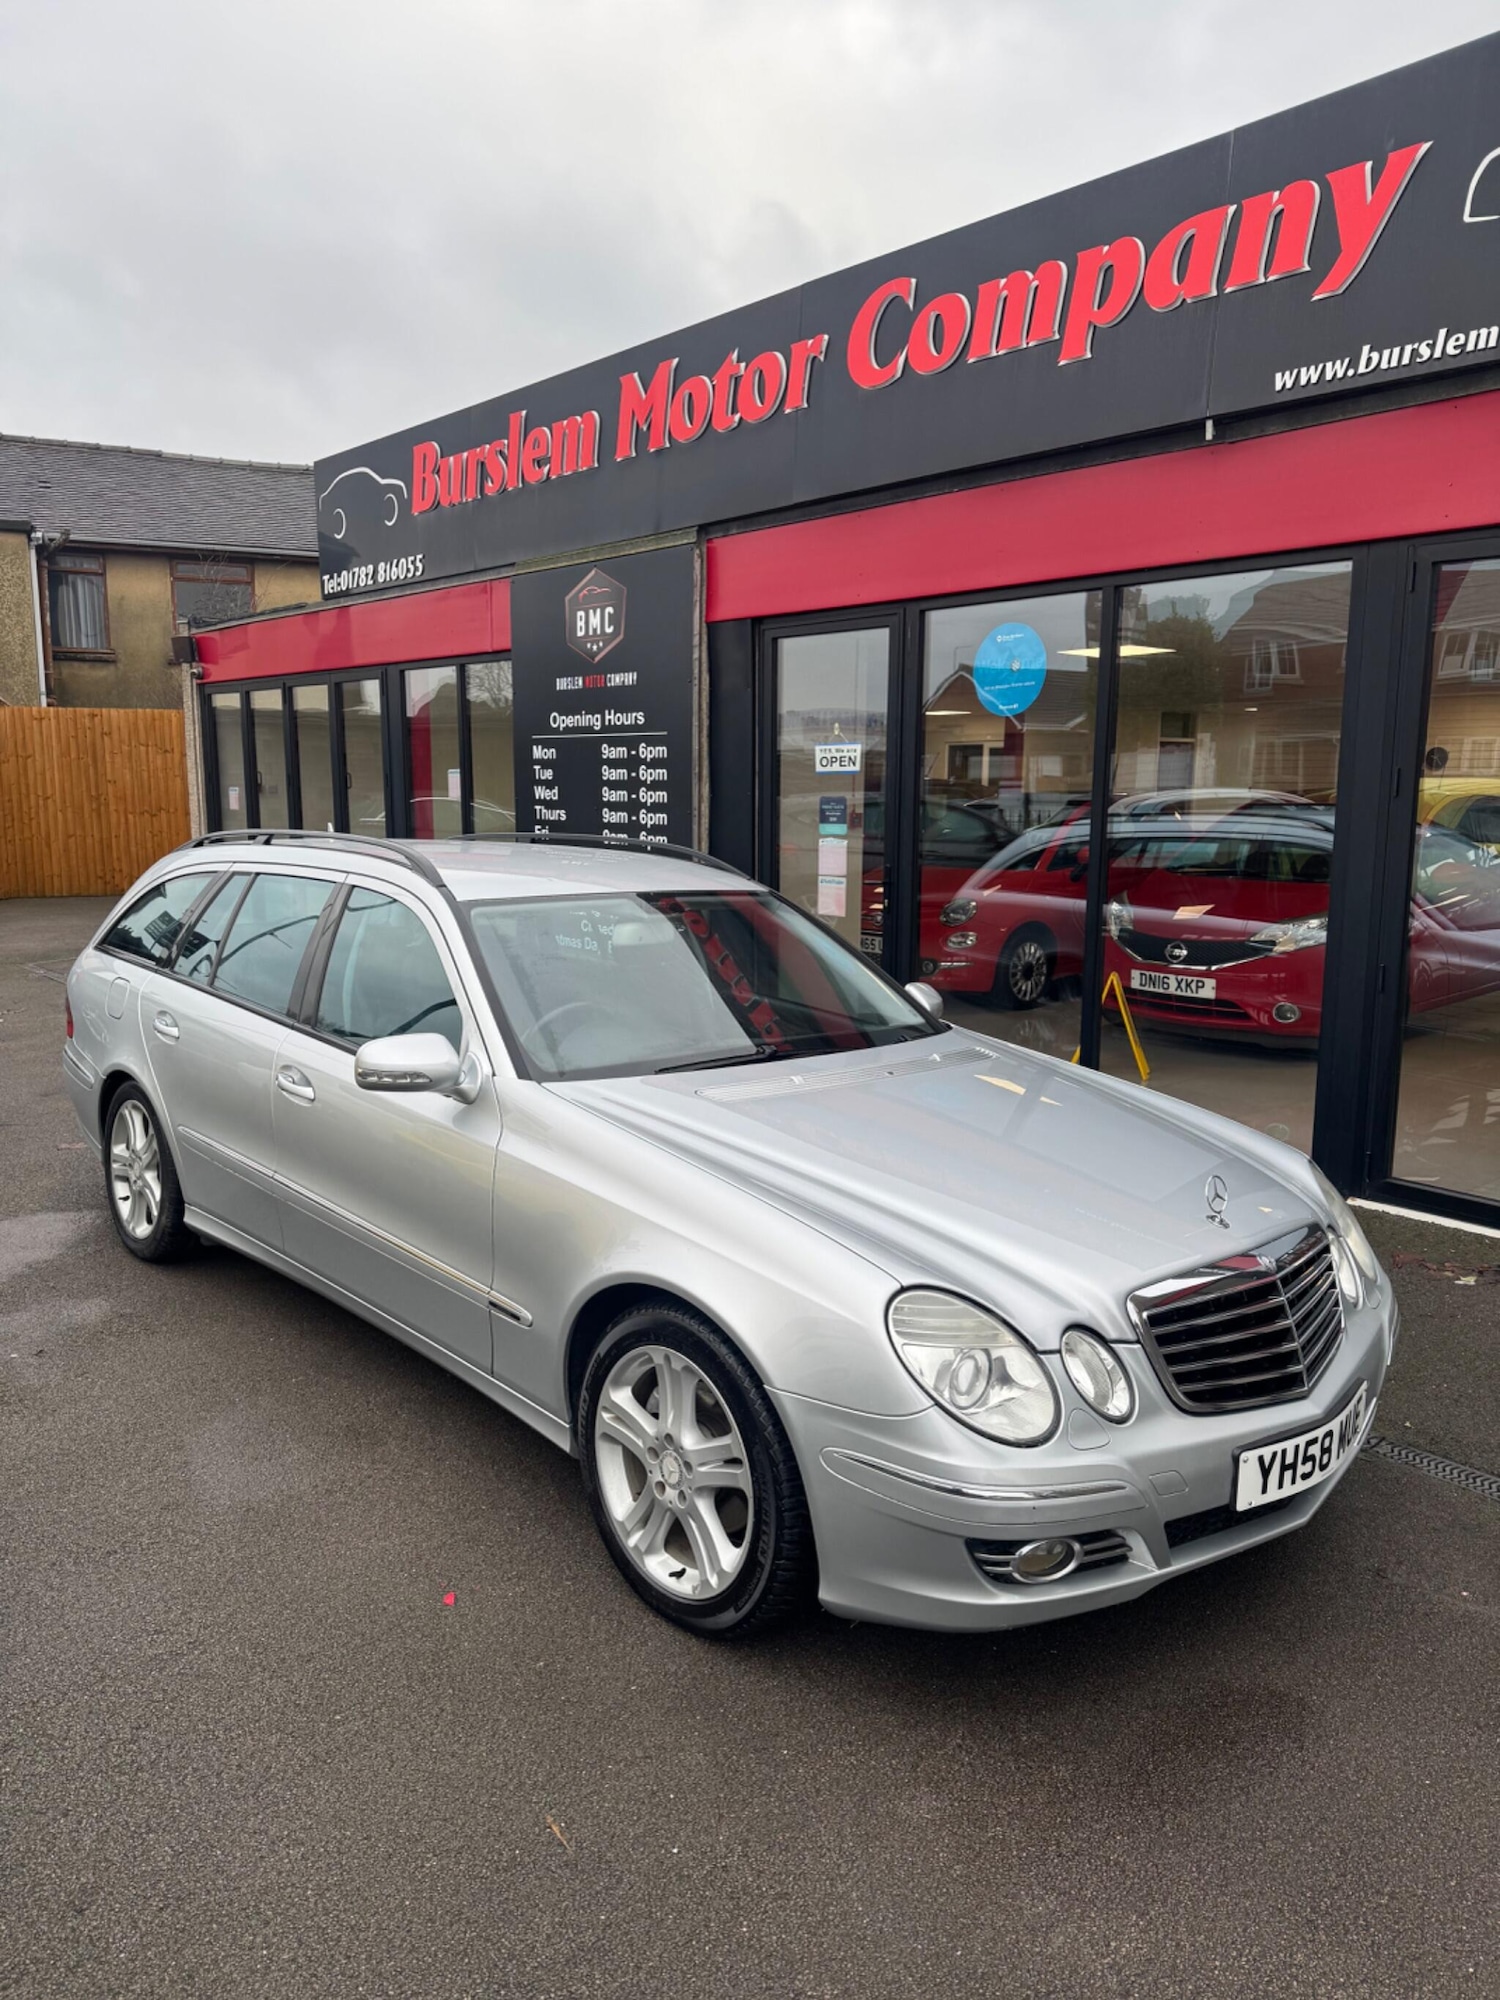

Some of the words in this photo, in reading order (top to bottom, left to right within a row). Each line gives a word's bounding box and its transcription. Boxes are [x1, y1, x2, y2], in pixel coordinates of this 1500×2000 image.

[411, 409, 601, 515] Burslem
[614, 333, 830, 462] Motor
[846, 139, 1434, 390] Company
[1274, 325, 1500, 392] www.burslem
[322, 564, 374, 595] Tel:01782
[377, 553, 424, 583] 816055
[576, 606, 615, 637] BMC
[556, 676, 583, 691] BURSLEM
[584, 674, 605, 688] MOTOR
[606, 671, 638, 687] COMPANY
[549, 711, 602, 731] Opening
[604, 709, 646, 726] Hours
[532, 745, 556, 760] Mon
[601, 743, 627, 760] 9am
[638, 743, 668, 762] 6pm
[819, 755, 857, 768] OPEN
[533, 765, 553, 781] Tue
[601, 765, 627, 781] 9am
[638, 765, 668, 784] 6pm
[534, 786, 559, 800] Wed
[602, 786, 628, 802] 9am
[639, 787, 668, 806] 6pm
[534, 805, 567, 821] Thurs
[602, 807, 628, 824] 9am
[639, 808, 668, 828] 6pm
[1139, 972, 1170, 991] DN16
[1174, 975, 1205, 994] XKP
[1258, 1429, 1334, 1495] YH58
